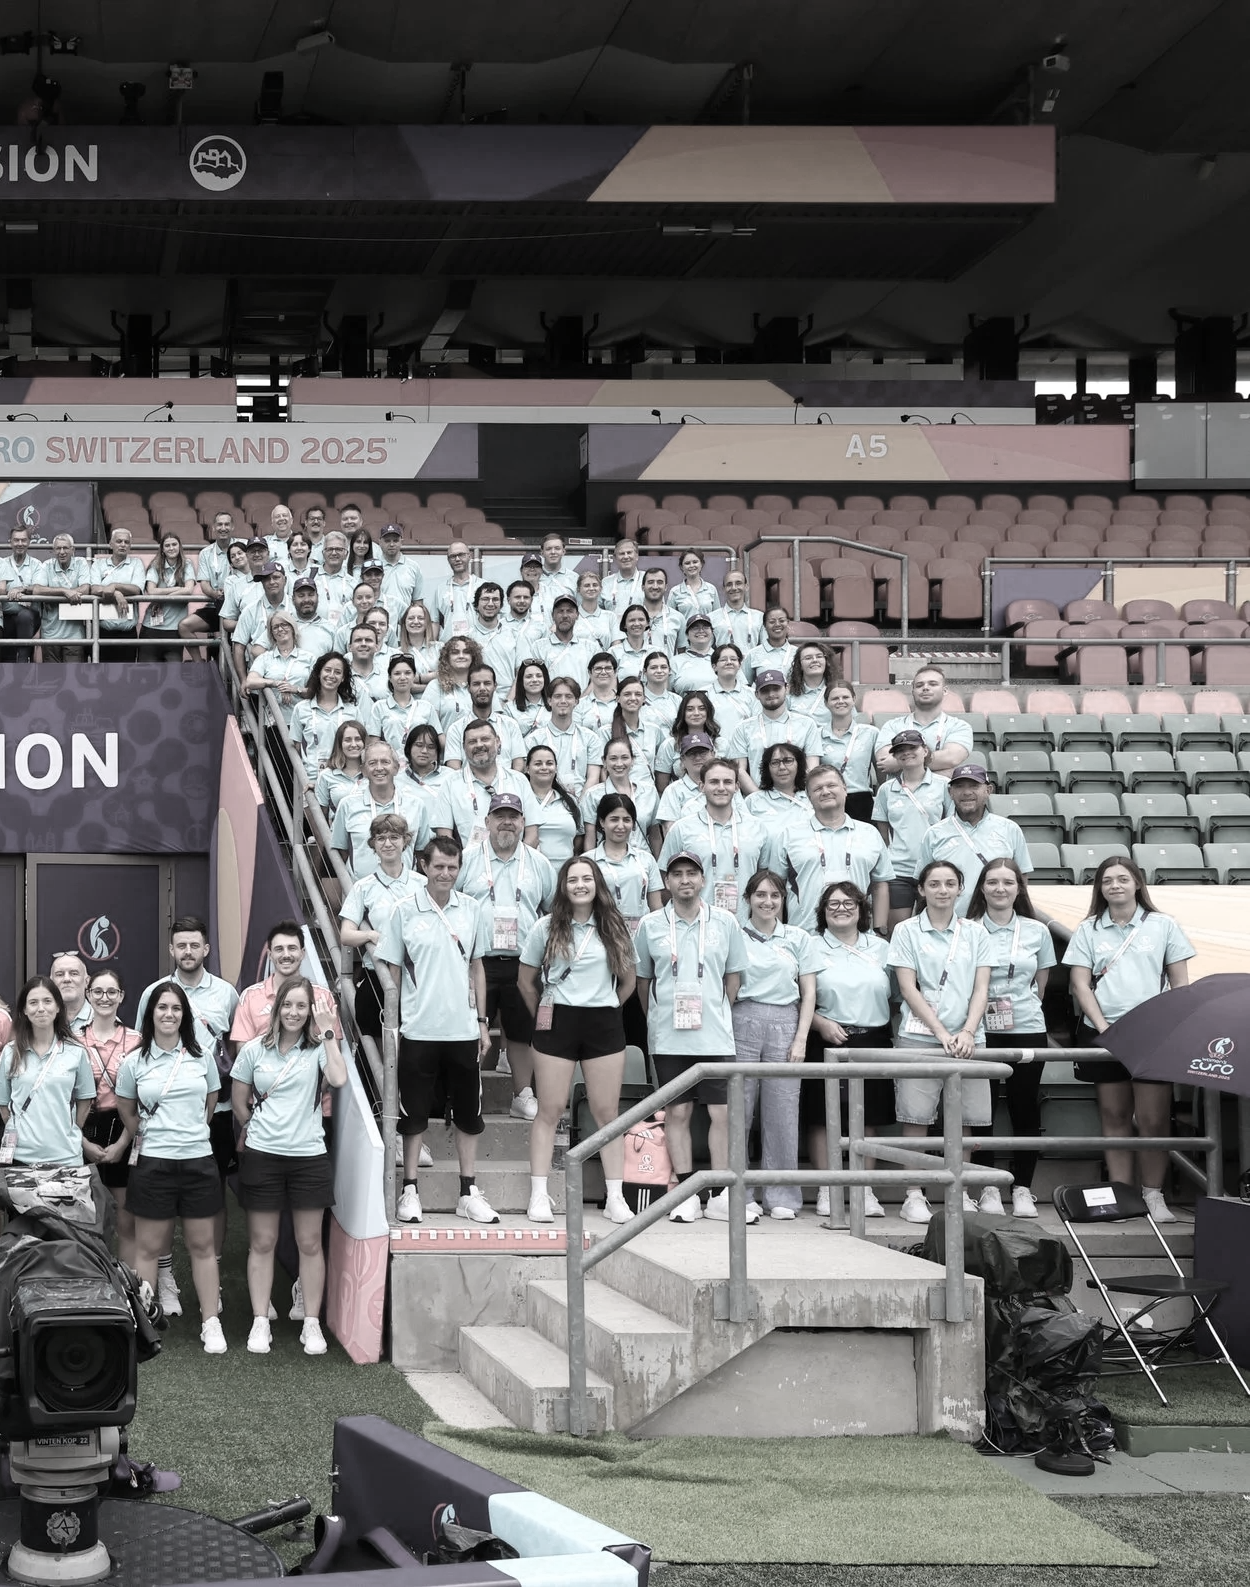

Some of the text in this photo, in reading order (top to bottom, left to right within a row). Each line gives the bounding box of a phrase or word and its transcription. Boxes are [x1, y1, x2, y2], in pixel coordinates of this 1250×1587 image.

[45, 436, 290, 464] SWITZERLAND
[301, 437, 388, 464] 2025
[845, 434, 888, 458] A5
